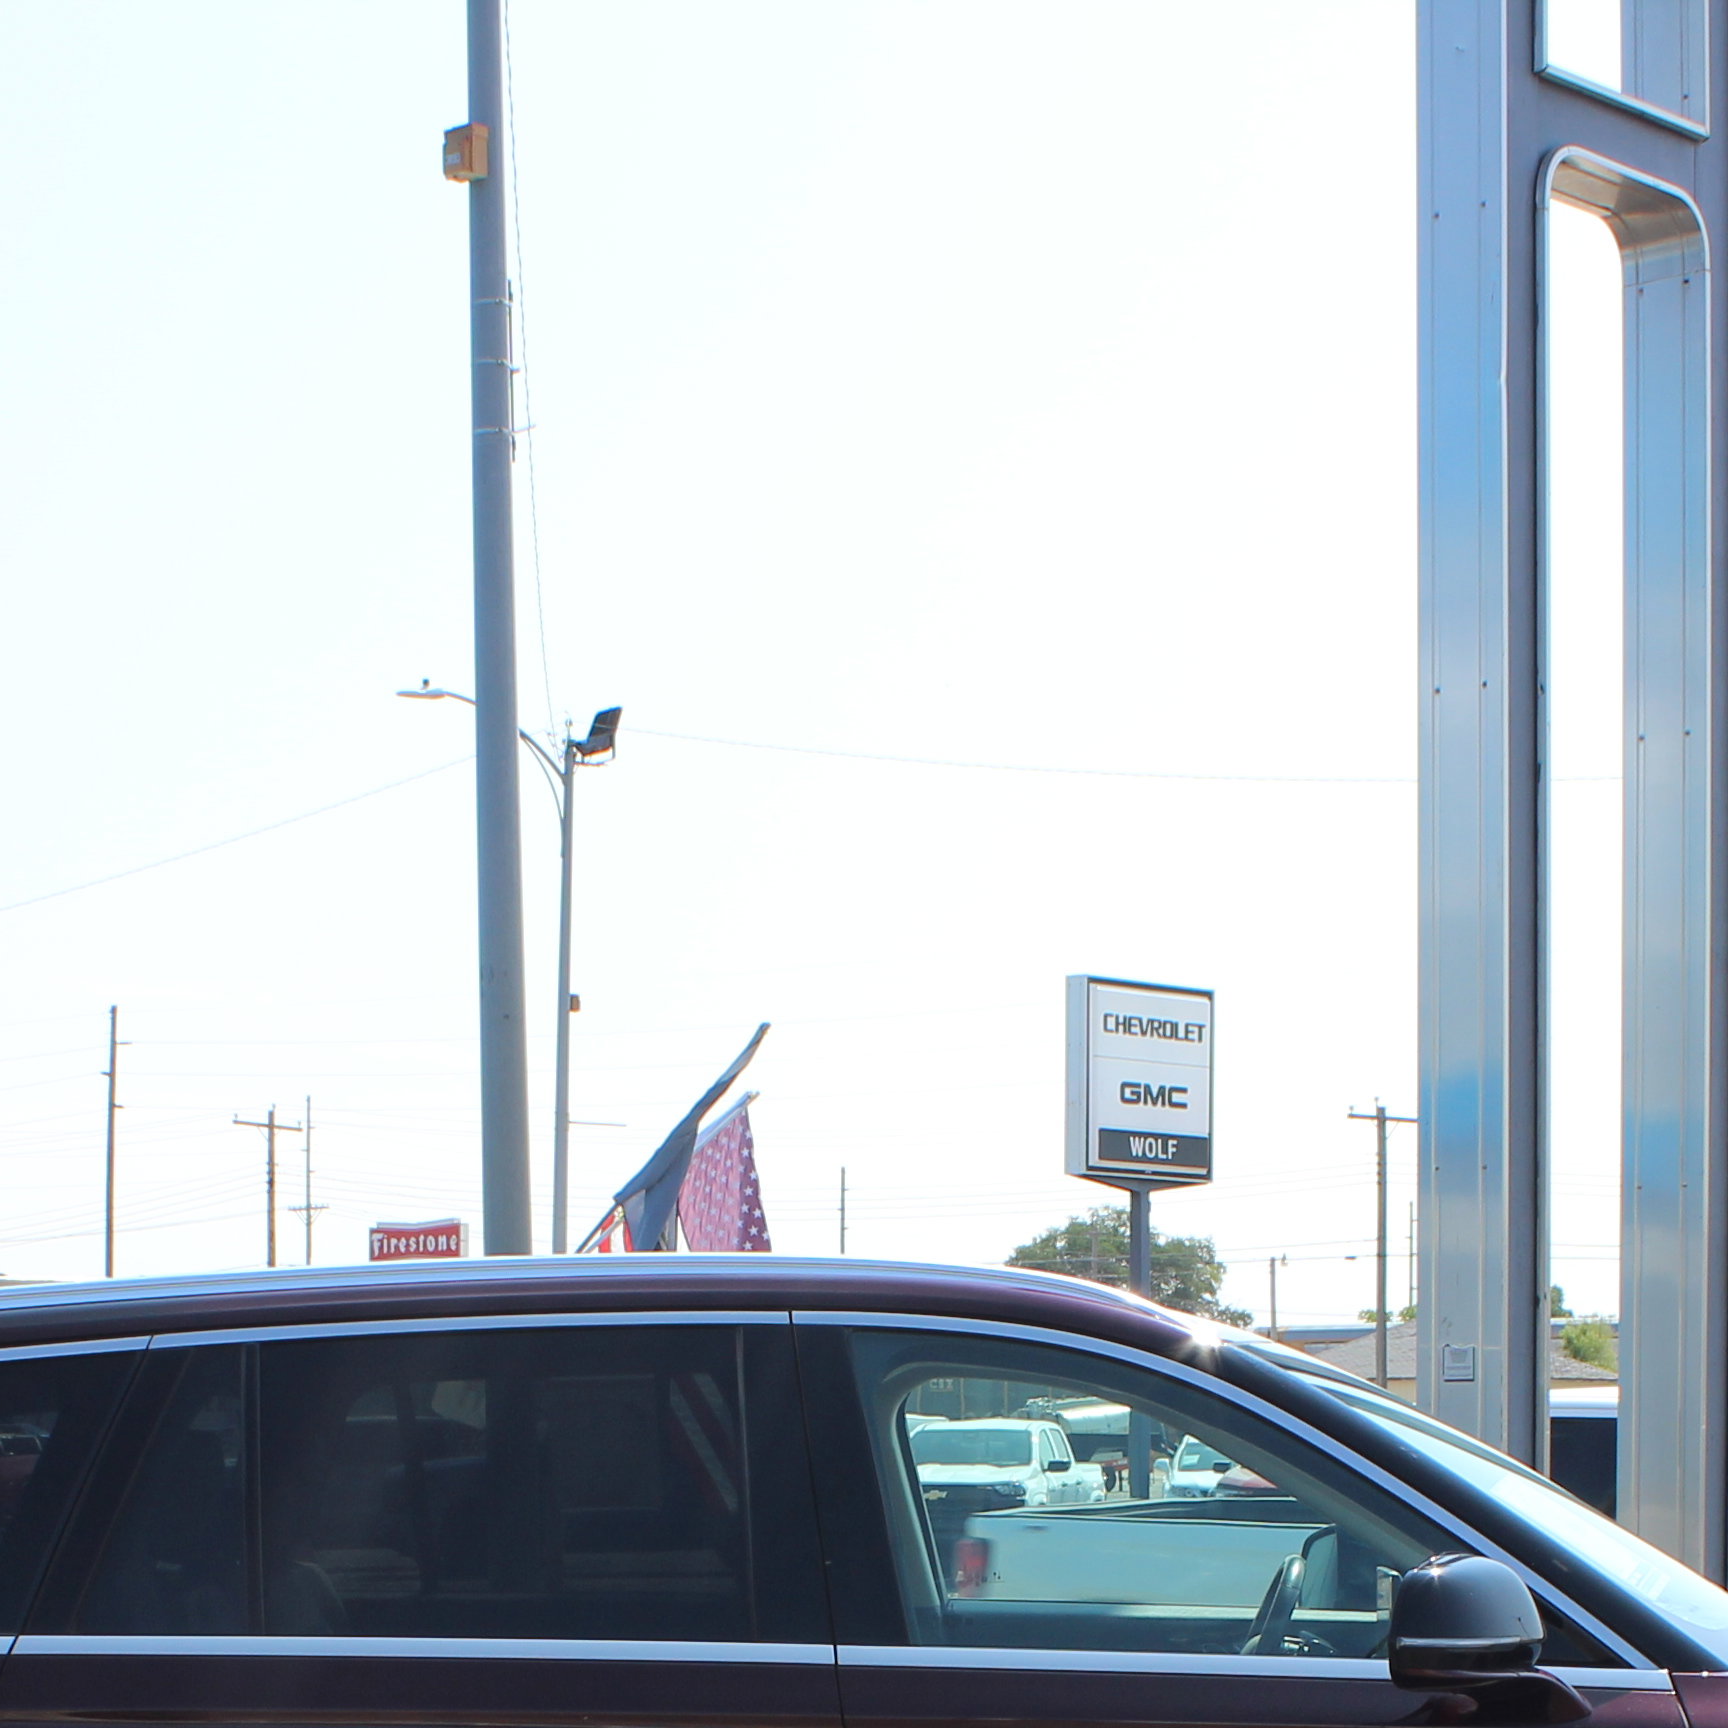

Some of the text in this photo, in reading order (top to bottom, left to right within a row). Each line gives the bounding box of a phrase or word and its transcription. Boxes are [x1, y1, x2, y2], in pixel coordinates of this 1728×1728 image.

[1103, 1013, 1206, 1043] CHEVROLET
[1120, 1081, 1188, 1109] GMC
[1129, 1136, 1178, 1160] WOLF
[371, 1232, 458, 1257] Firestone
